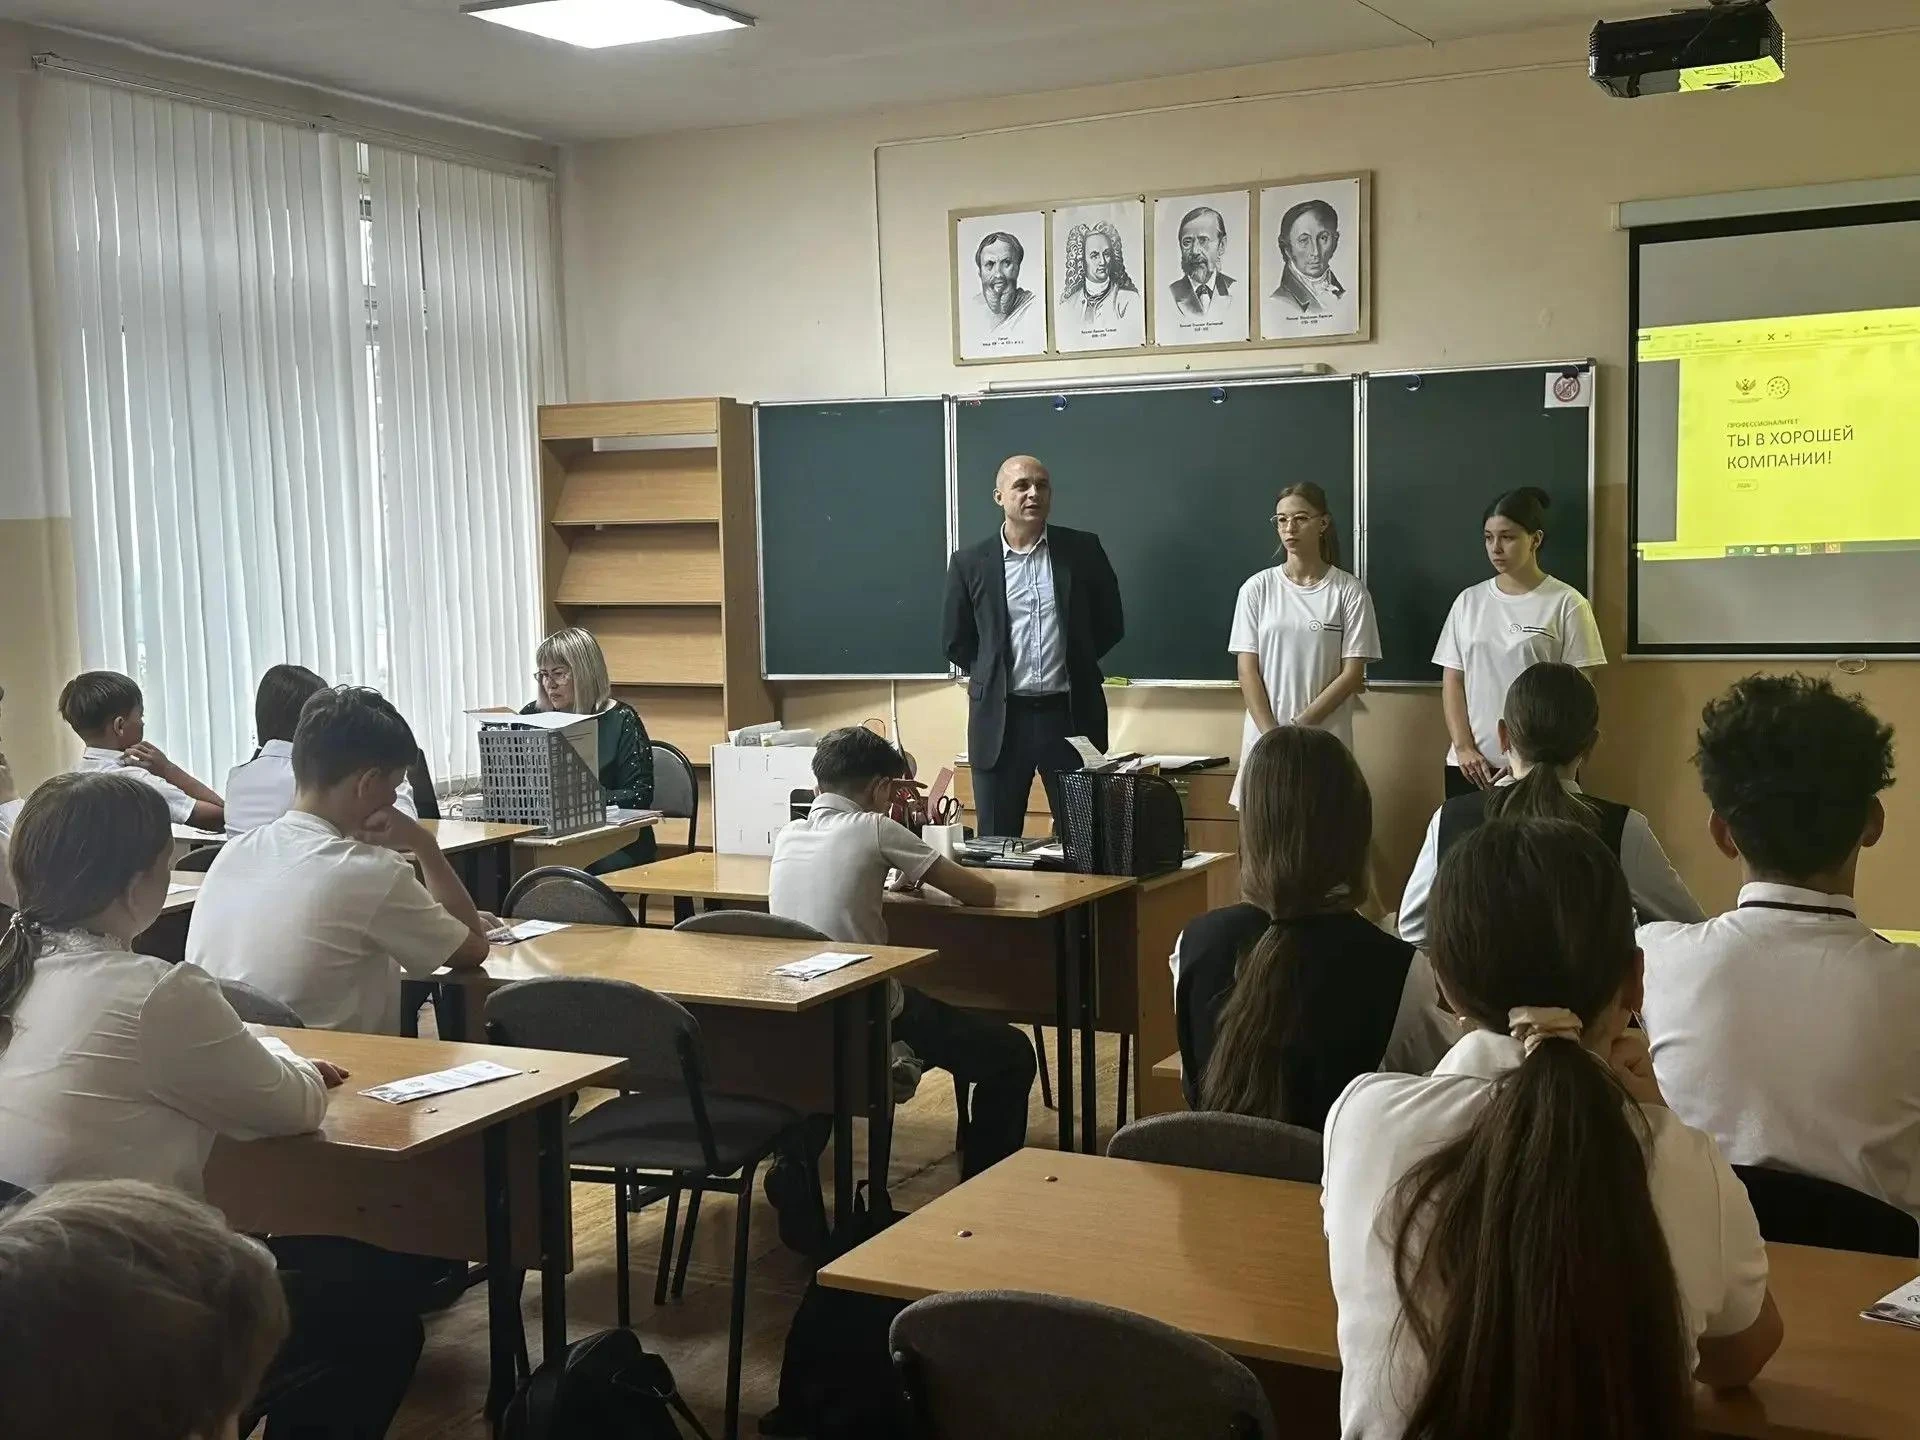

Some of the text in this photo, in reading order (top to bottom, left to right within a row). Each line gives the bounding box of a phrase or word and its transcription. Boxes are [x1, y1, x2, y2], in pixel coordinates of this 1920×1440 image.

[1727, 418, 1799, 428] ПРОФЕССИОНАЛИТЕТ
[1726, 424, 1854, 447] ТЫ В ХОРОШЕЙ
[1727, 450, 1832, 470] КОМПАНИИ!
